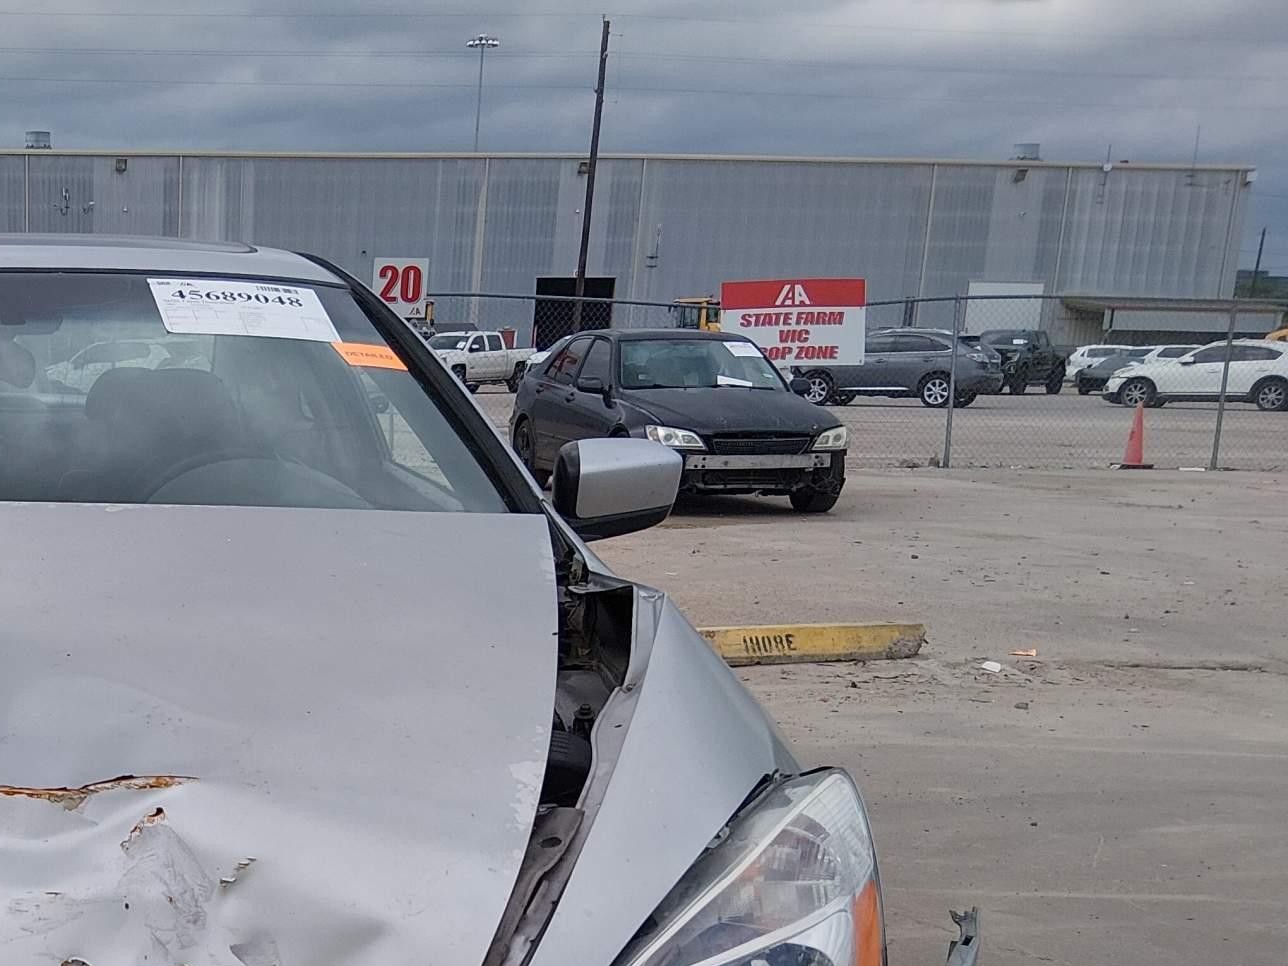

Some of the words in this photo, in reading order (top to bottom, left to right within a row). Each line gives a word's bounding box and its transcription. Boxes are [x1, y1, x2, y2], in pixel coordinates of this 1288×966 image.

[378, 265, 422, 304] 20
[171, 289, 304, 308] 45689048
[739, 312, 792, 328] STATE
[795, 311, 845, 326] FARM
[778, 328, 810, 343] VIC
[795, 345, 840, 360] ZONE
